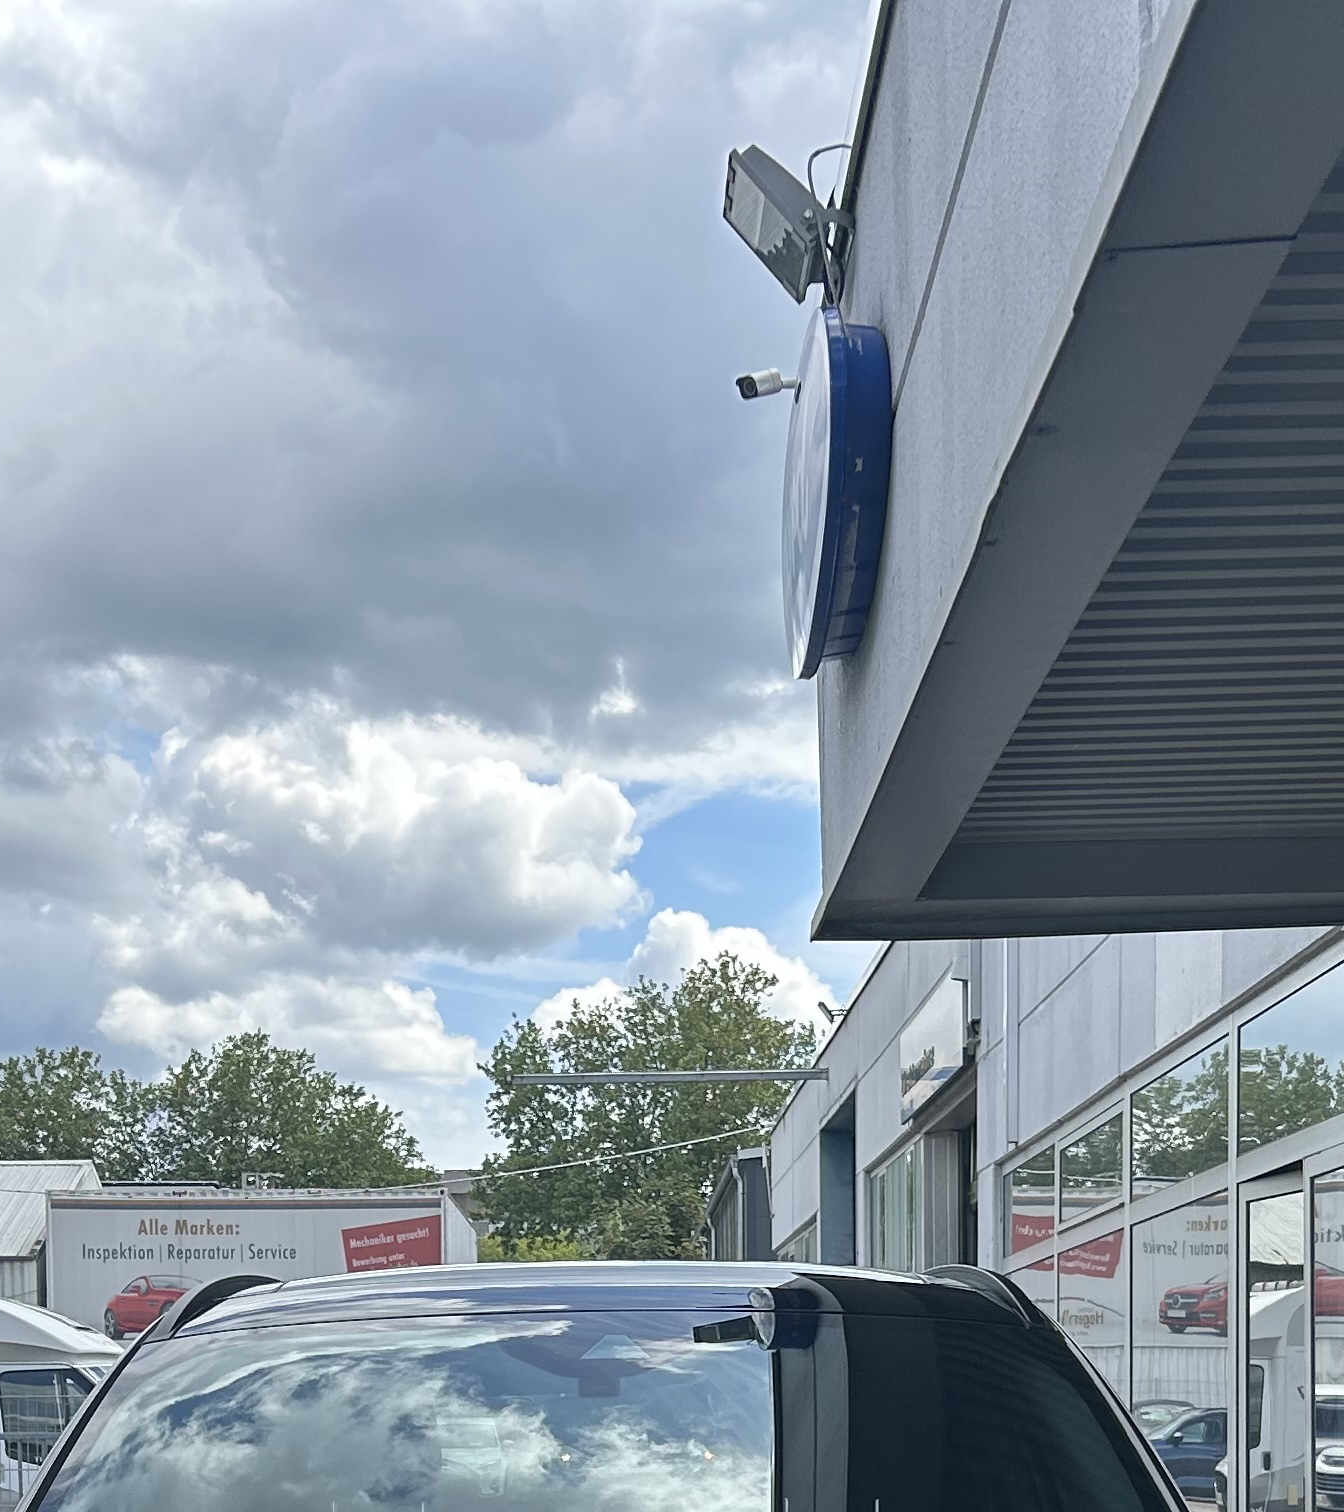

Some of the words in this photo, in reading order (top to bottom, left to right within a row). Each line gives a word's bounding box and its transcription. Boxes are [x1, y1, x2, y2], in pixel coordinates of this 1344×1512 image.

[136, 1218, 169, 1236] Alle
[174, 1218, 241, 1236] Marken:
[349, 1232, 395, 1249] Mechaniker
[82, 1242, 155, 1264] Inspektion
[167, 1243, 236, 1264] Reparatur
[248, 1243, 297, 1261] Service
